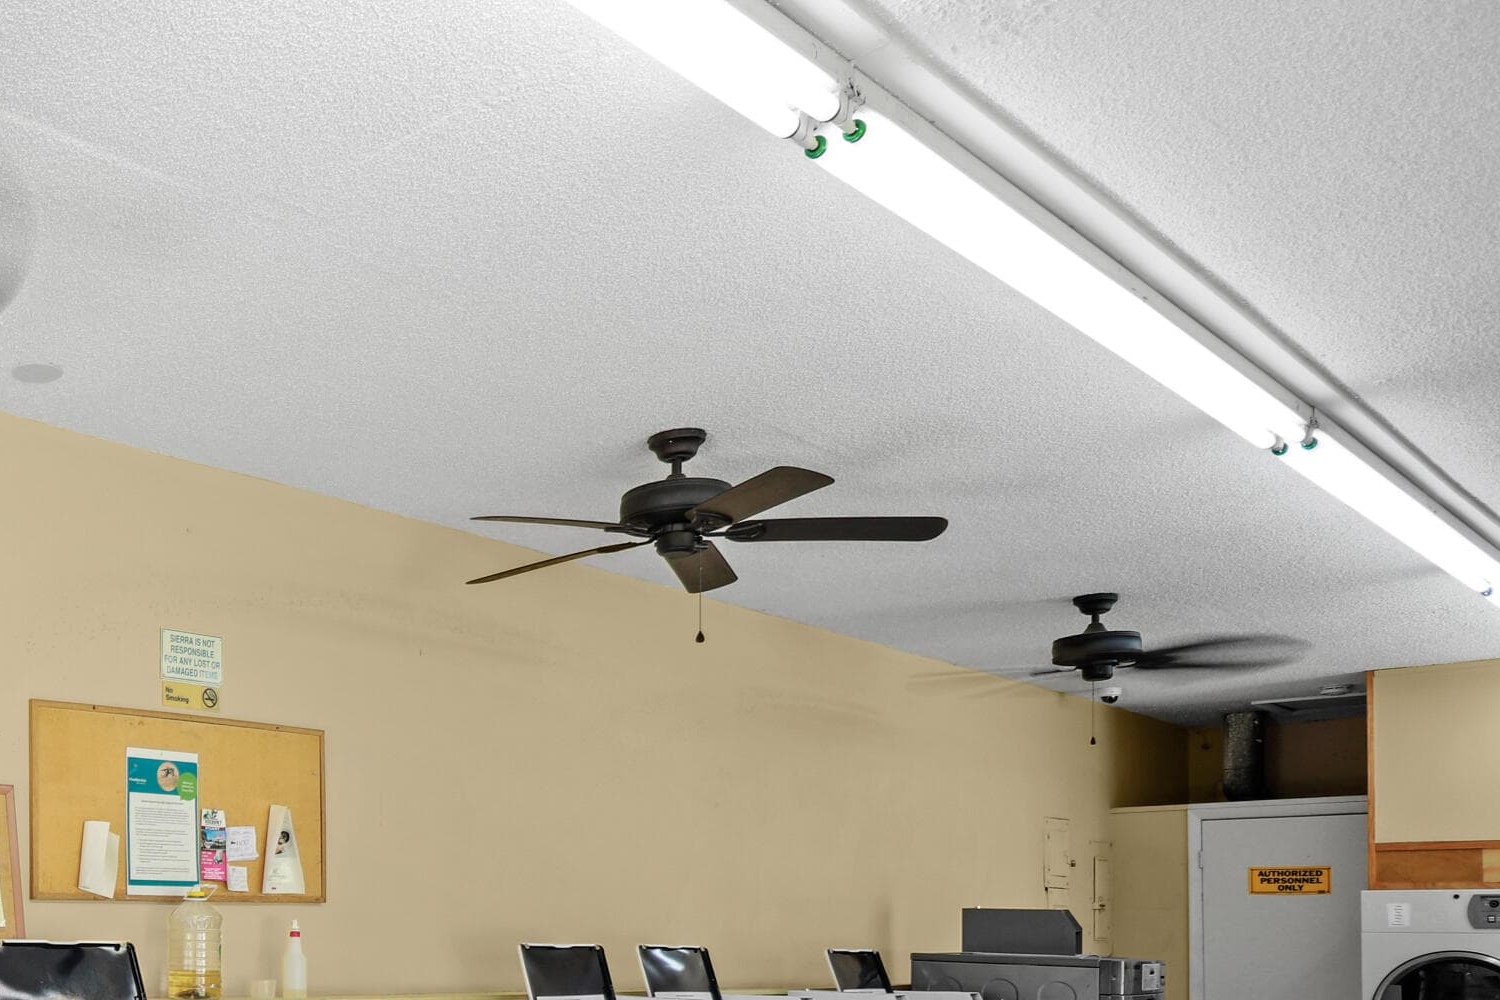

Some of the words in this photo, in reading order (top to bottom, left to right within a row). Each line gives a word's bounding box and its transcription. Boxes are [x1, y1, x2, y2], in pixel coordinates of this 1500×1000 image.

[170, 634, 193, 645] SIERRA
[195, 638, 202, 646] IS
[202, 639, 215, 648] NOT
[170, 645, 214, 659] RESPONSIBLE
[164, 654, 177, 664] FOR
[179, 657, 192, 666] ANY
[194, 659, 210, 668] LOST
[211, 661, 220, 669] OR
[167, 664, 198, 677] DAMAGED
[199, 670, 218, 679] ITEMS
[165, 694, 189, 704] Smoking
